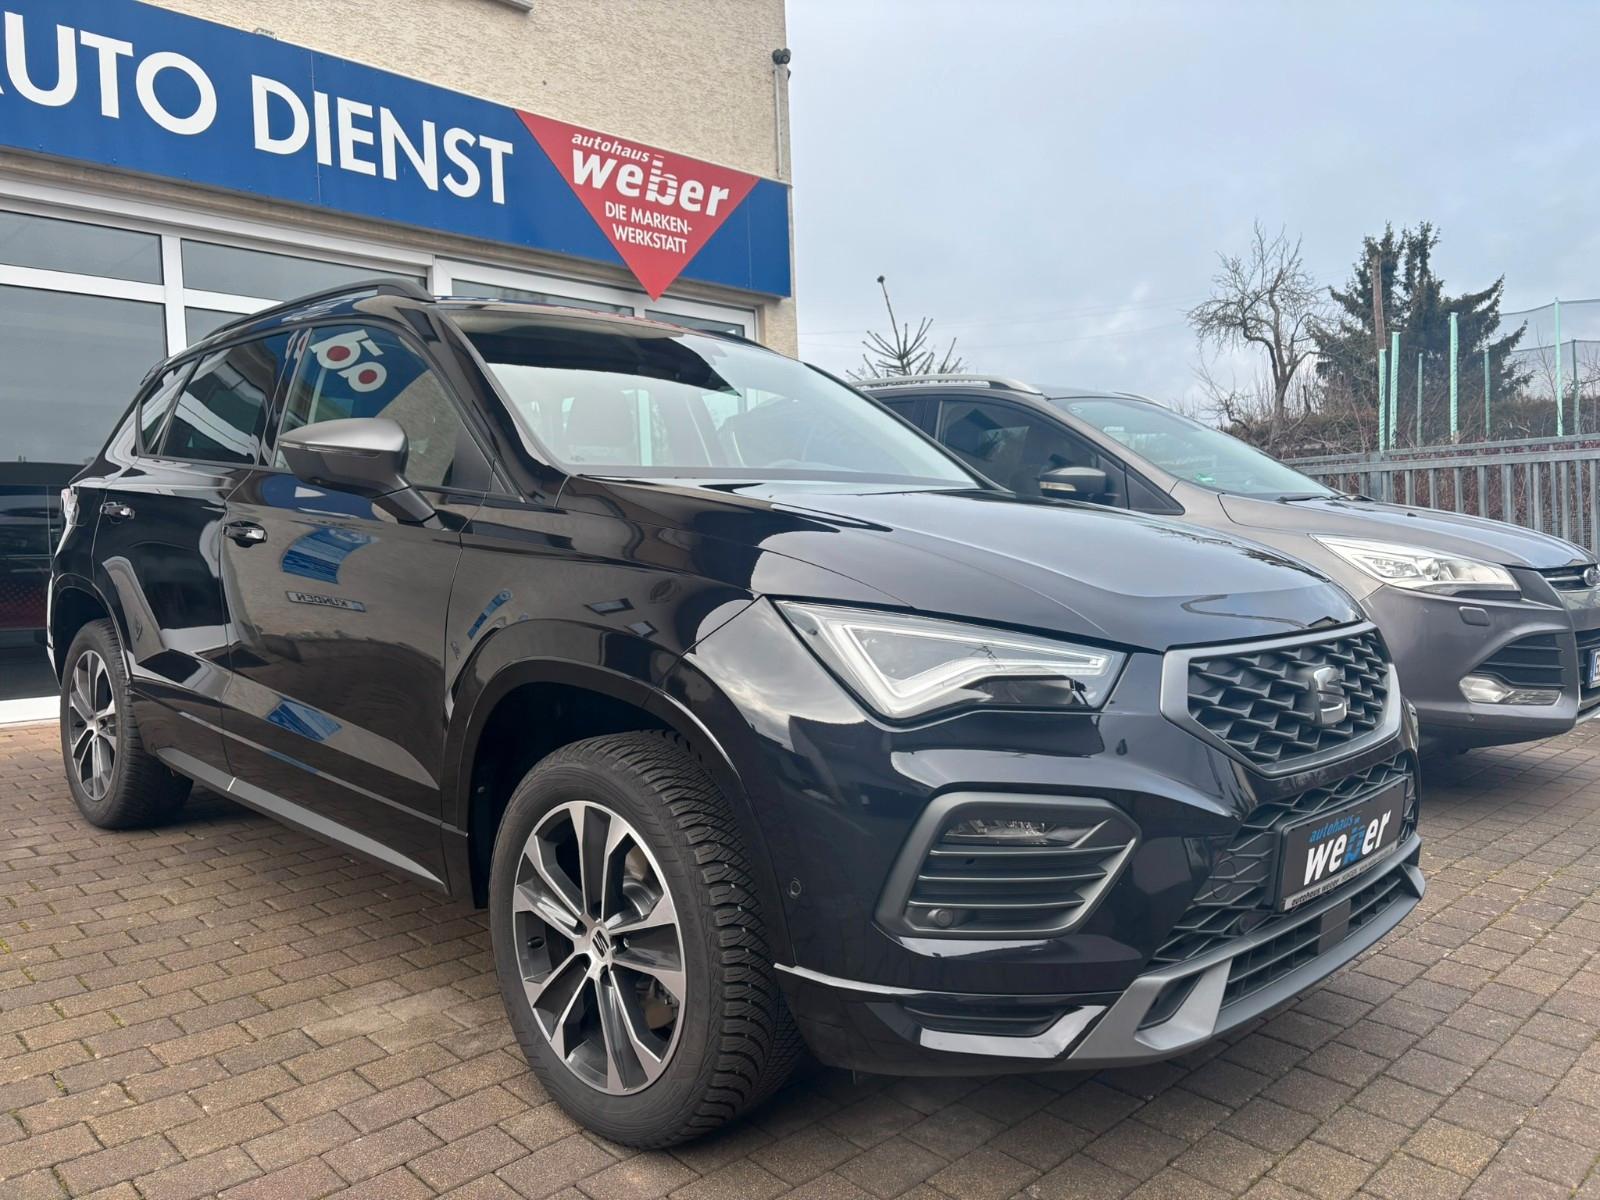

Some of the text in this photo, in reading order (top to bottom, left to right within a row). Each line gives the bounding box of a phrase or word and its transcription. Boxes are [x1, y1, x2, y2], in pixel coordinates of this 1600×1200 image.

[0, 11, 514, 205] UTO DIENST
[571, 133, 650, 162] autohaus
[572, 149, 730, 217] weber
[605, 201, 692, 235] DIE MARKEN-
[612, 223, 687, 254] WERKSTATT
[1308, 815, 1354, 843] autohaus
[1303, 809, 1392, 886] weber
